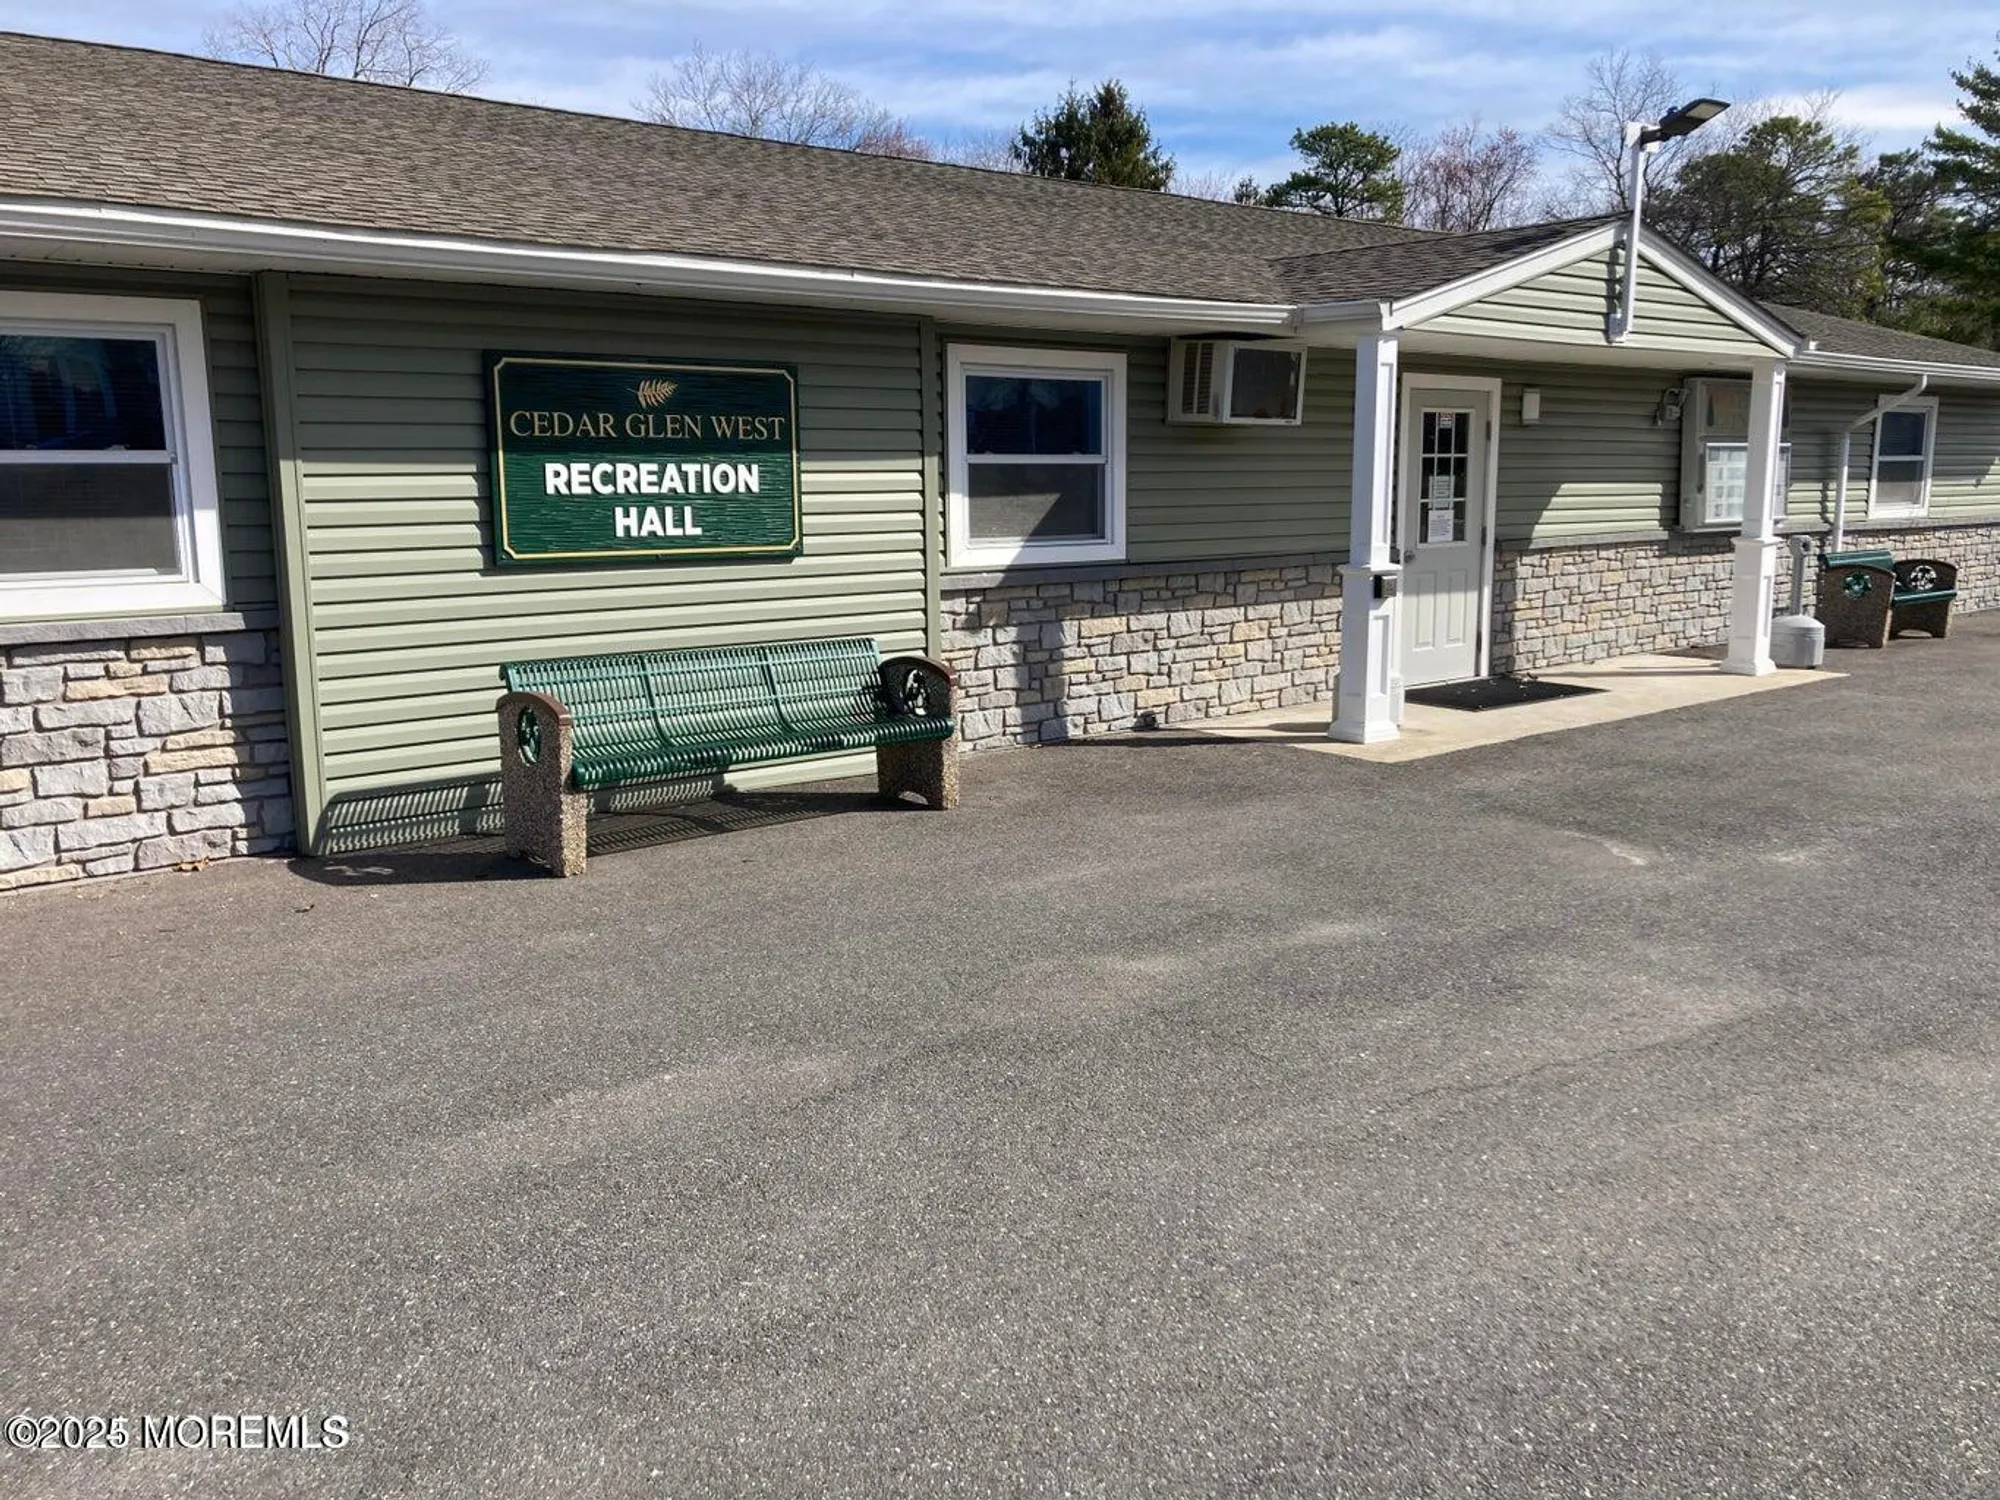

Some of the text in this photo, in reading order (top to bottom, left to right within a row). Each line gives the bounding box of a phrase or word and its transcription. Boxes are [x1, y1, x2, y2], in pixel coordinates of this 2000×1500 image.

[509, 410, 786, 441] CEDAR GLEN WEST
[544, 462, 760, 495] RECREATION
[614, 505, 703, 537] HALL
